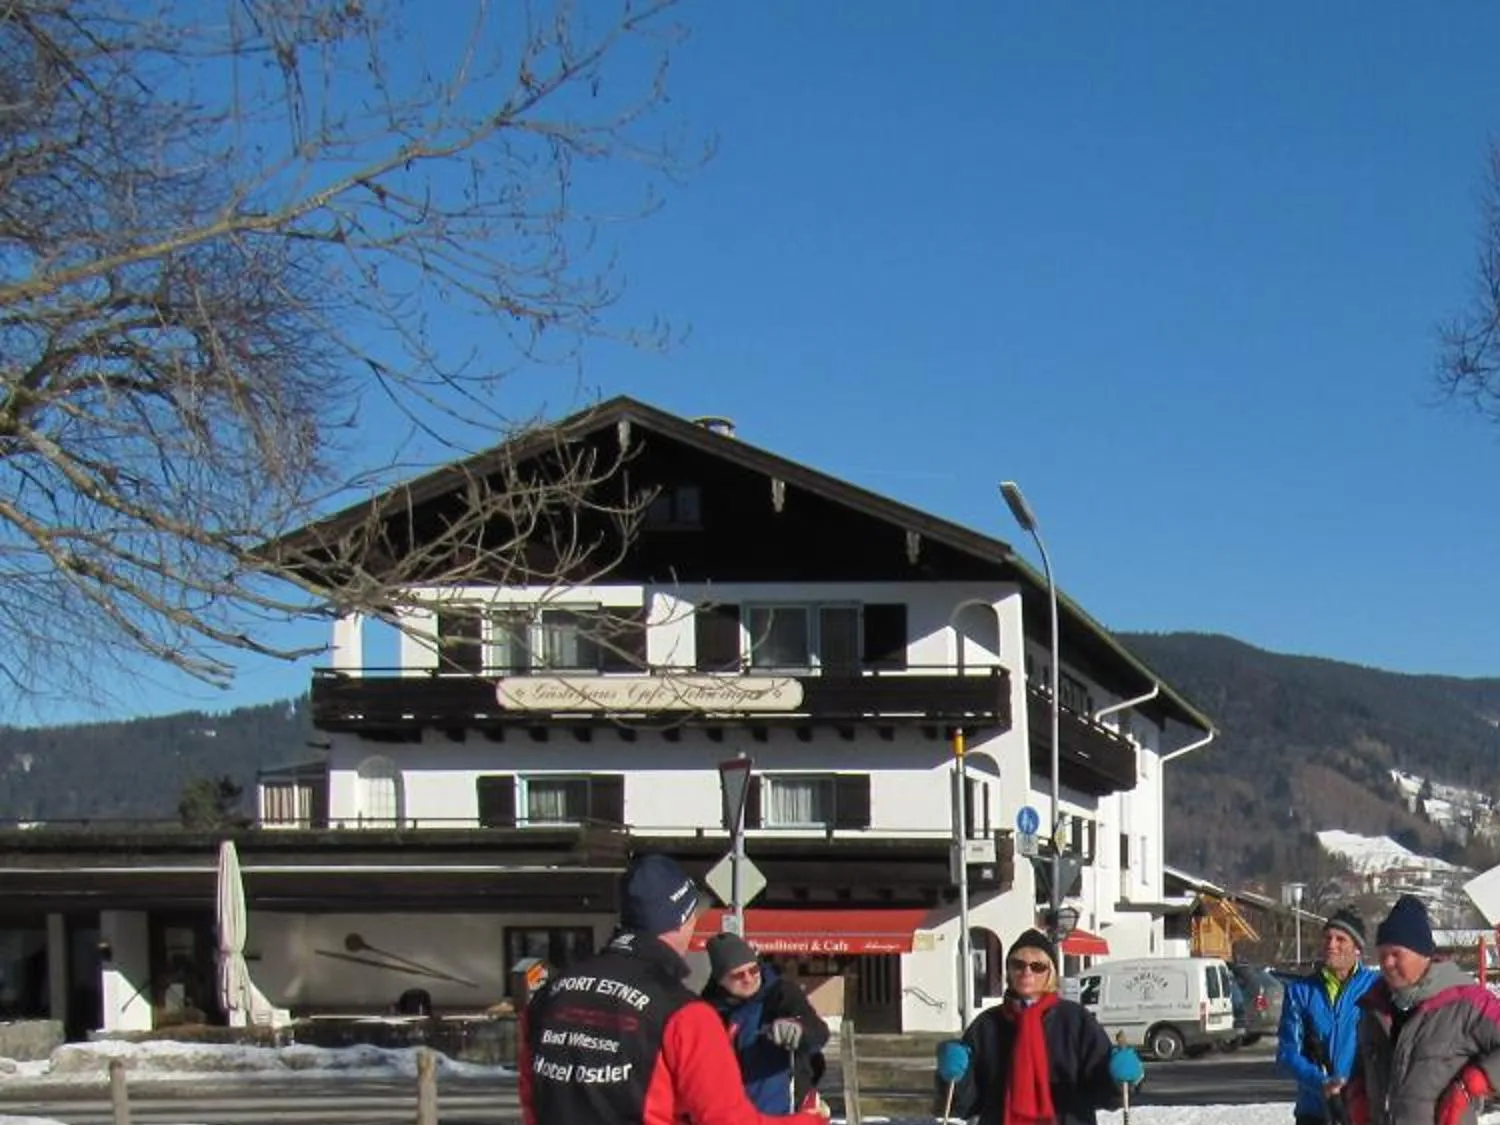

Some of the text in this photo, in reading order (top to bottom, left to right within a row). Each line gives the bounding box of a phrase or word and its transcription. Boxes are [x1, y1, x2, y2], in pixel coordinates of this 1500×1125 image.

[550, 976, 651, 1011] SPORT ESTNER
[541, 1029, 567, 1046] Bad
[533, 1055, 633, 1083] Hotel Ostler
